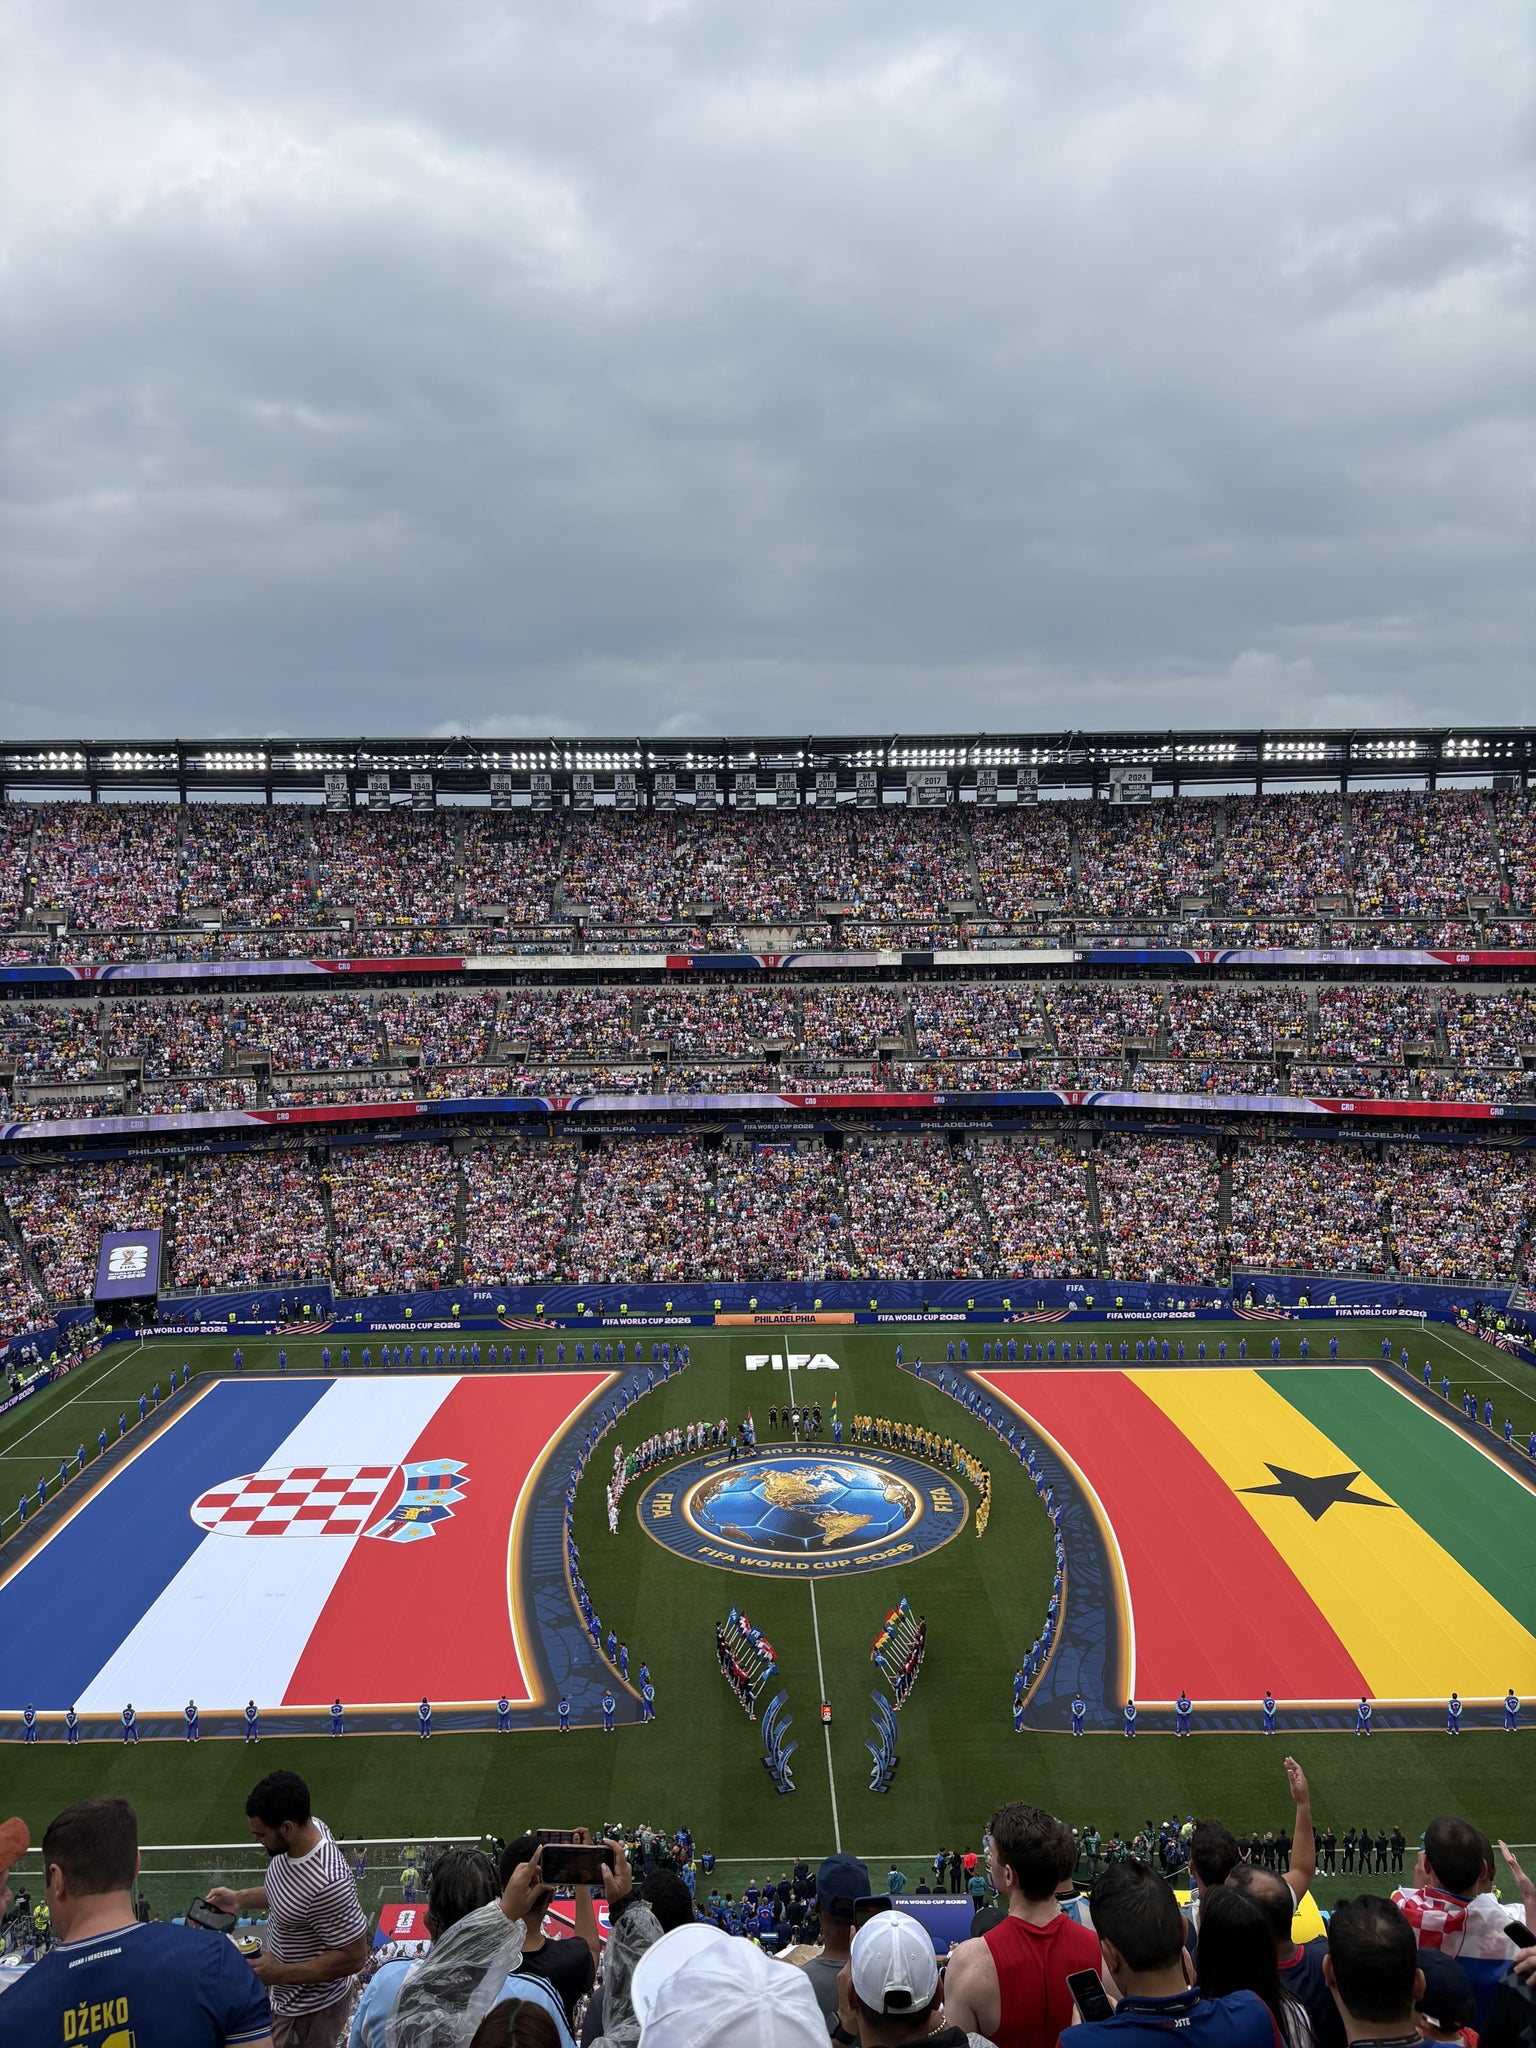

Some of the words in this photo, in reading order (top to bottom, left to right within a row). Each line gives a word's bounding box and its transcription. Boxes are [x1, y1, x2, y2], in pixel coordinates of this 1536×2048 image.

[328, 782, 345, 790] 1947
[371, 782, 388, 790] 1948
[414, 782, 430, 790] 1949
[493, 782, 509, 790] 1960
[533, 782, 550, 790] 1980
[576, 782, 592, 790] 1988
[1456, 954, 1470, 962] CRO
[933, 1096, 945, 1104] CRO
[415, 1104, 428, 1112] CRO
[1341, 1103, 1354, 1111] CRO
[1490, 1107, 1504, 1116] CRO
[131, 1120, 144, 1129] CRO
[1338, 1131, 1421, 1140] PHILADELPHIA
[128, 1145, 210, 1156] PHILADELPHIA
[1398, 1309, 1427, 1317] 2026
[754, 1315, 816, 1323] PHILADELPHIA
[745, 1353, 840, 1371] FIFA
[796, 1448, 855, 1456] WORLD
[858, 1452, 893, 1464] FIFA
[929, 1487, 953, 1513] FIFA
[652, 1493, 674, 1518] FIFA
[698, 1546, 736, 1562] FIFA
[740, 1556, 809, 1570] WORLD
[813, 1559, 850, 1570] CUP
[853, 1542, 915, 1565] 2026
[64, 1997, 128, 2042] DŽEKO
